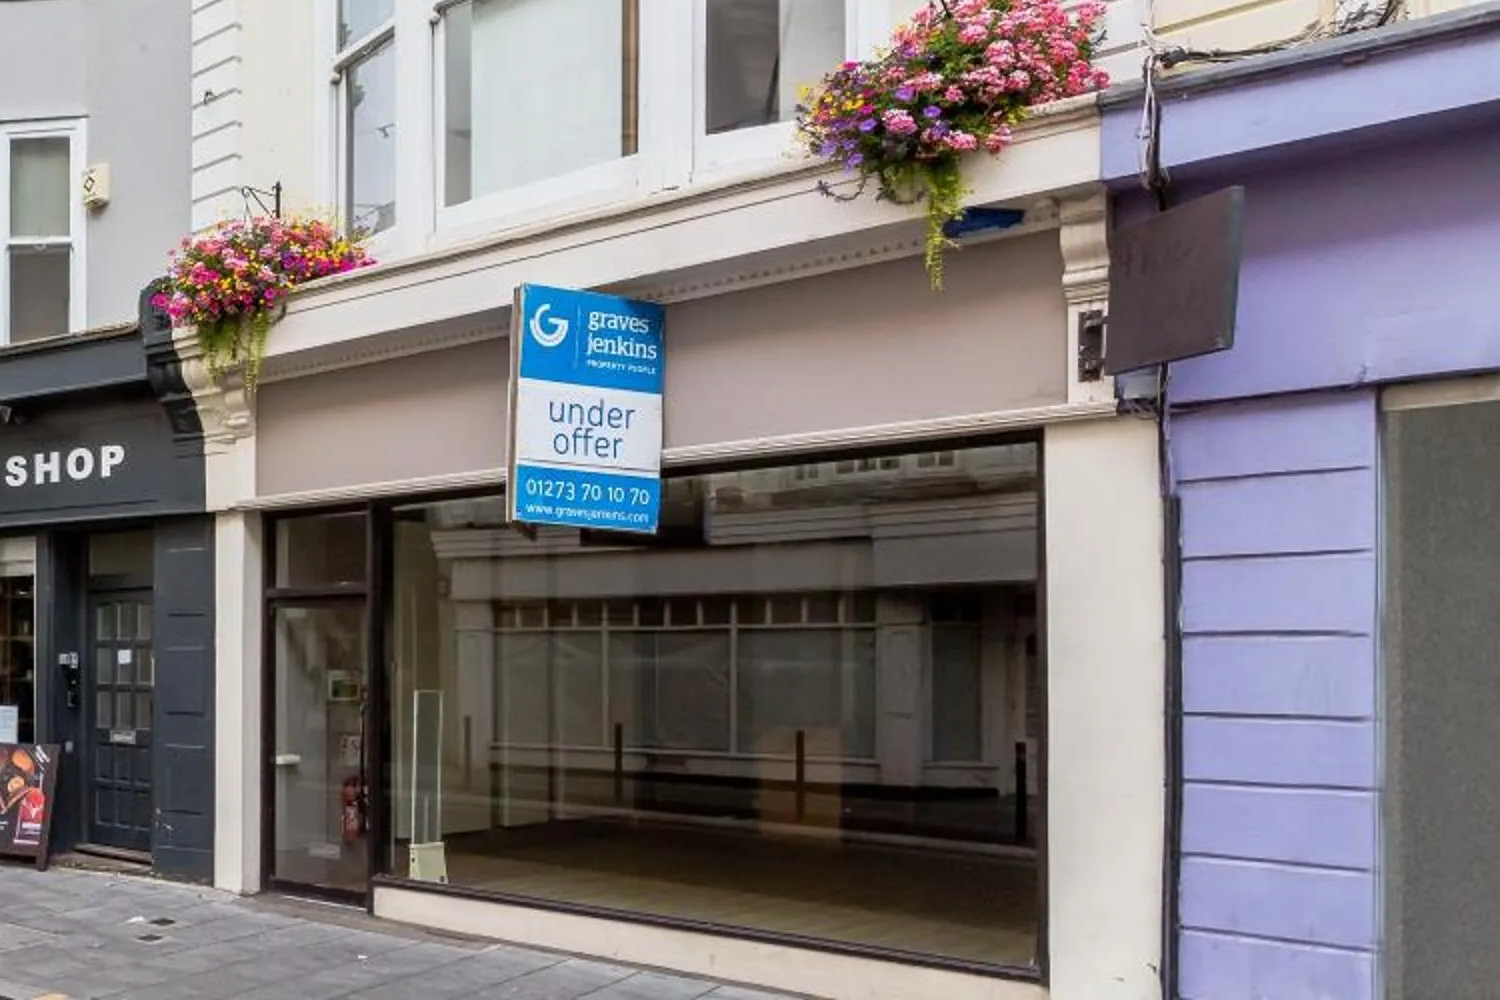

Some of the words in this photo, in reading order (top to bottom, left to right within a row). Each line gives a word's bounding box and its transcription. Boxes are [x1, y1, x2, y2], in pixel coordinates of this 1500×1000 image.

[587, 311, 650, 334] graves
[586, 332, 658, 360] jenkins
[548, 398, 636, 430] under
[552, 427, 623, 459] offer
[4, 445, 125, 488] SHOP
[525, 478, 576, 502] 01273
[580, 482, 603, 502] 70
[607, 486, 625, 503] 10
[629, 487, 650, 506] 70
